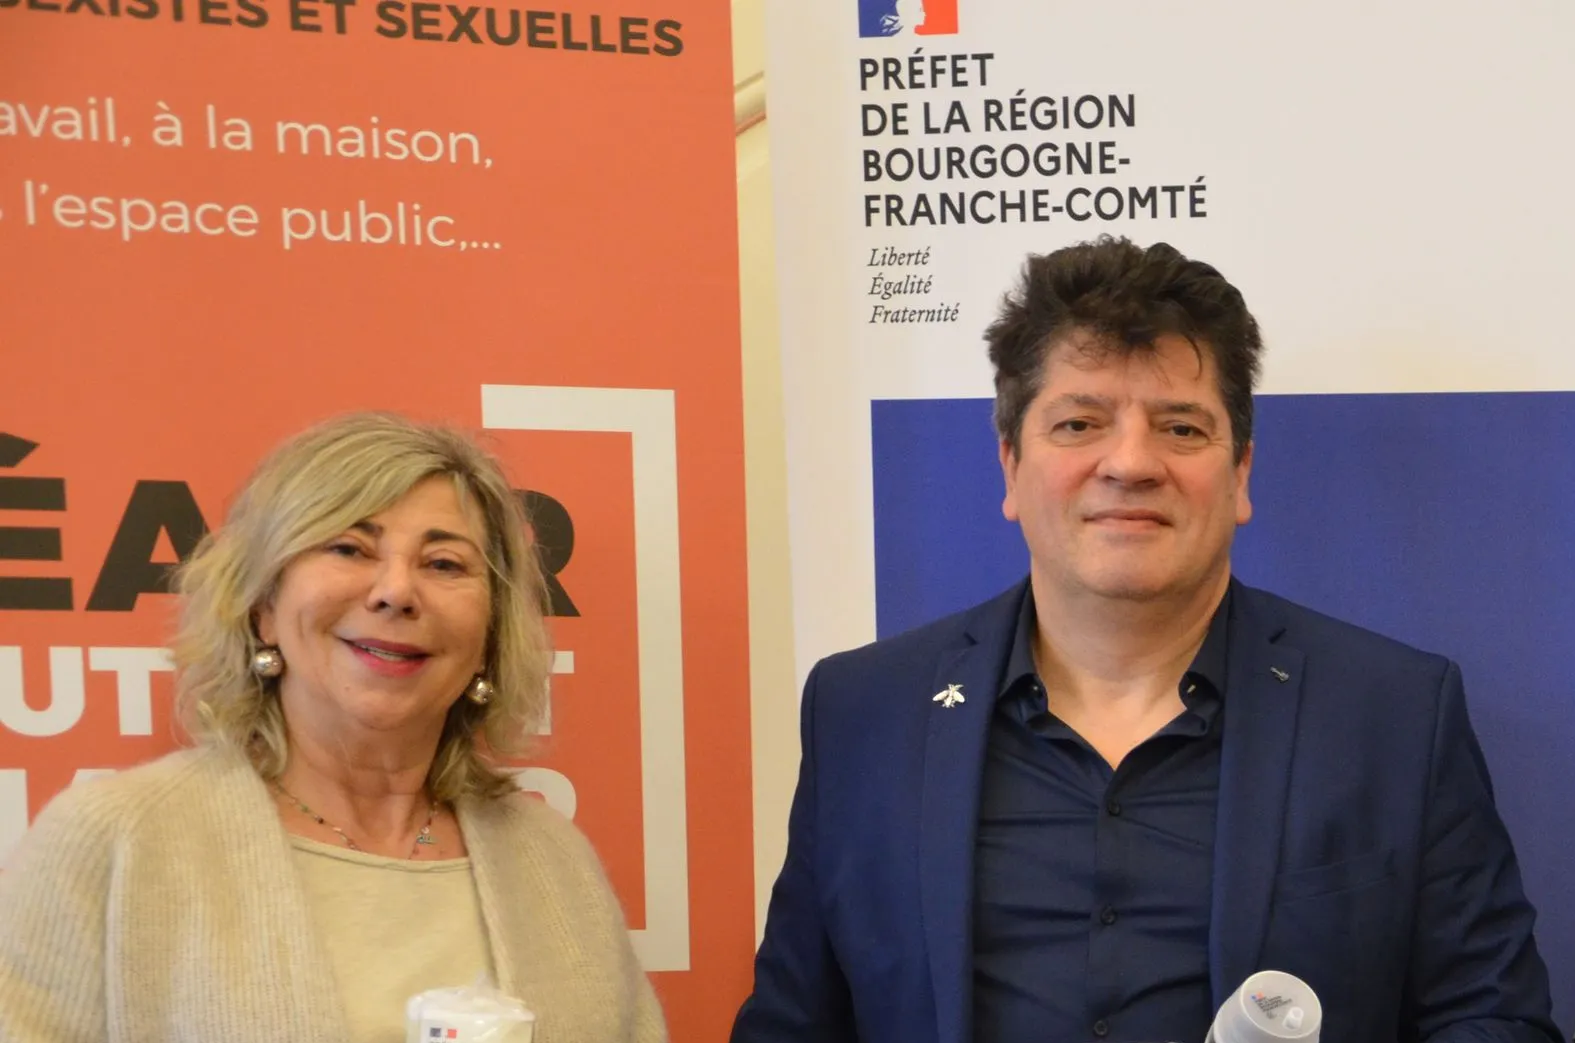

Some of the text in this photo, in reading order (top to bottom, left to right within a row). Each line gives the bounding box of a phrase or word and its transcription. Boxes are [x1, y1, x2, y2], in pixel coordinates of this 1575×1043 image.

[287, 0, 355, 34] ET
[375, 0, 684, 57] SEXUELLES
[860, 47, 994, 91] PRÉFET
[152, 100, 183, 147] à
[206, 103, 253, 151] la
[276, 116, 493, 169] maison,
[861, 89, 1136, 137] DE LA RÉGION
[863, 141, 1130, 182] BOURGOGNE-
[864, 176, 1207, 227] FRANCHE-COMTÉ
[867, 246, 931, 267] Liberté
[868, 272, 933, 300] Égalité
[868, 302, 960, 324] Fraternité
